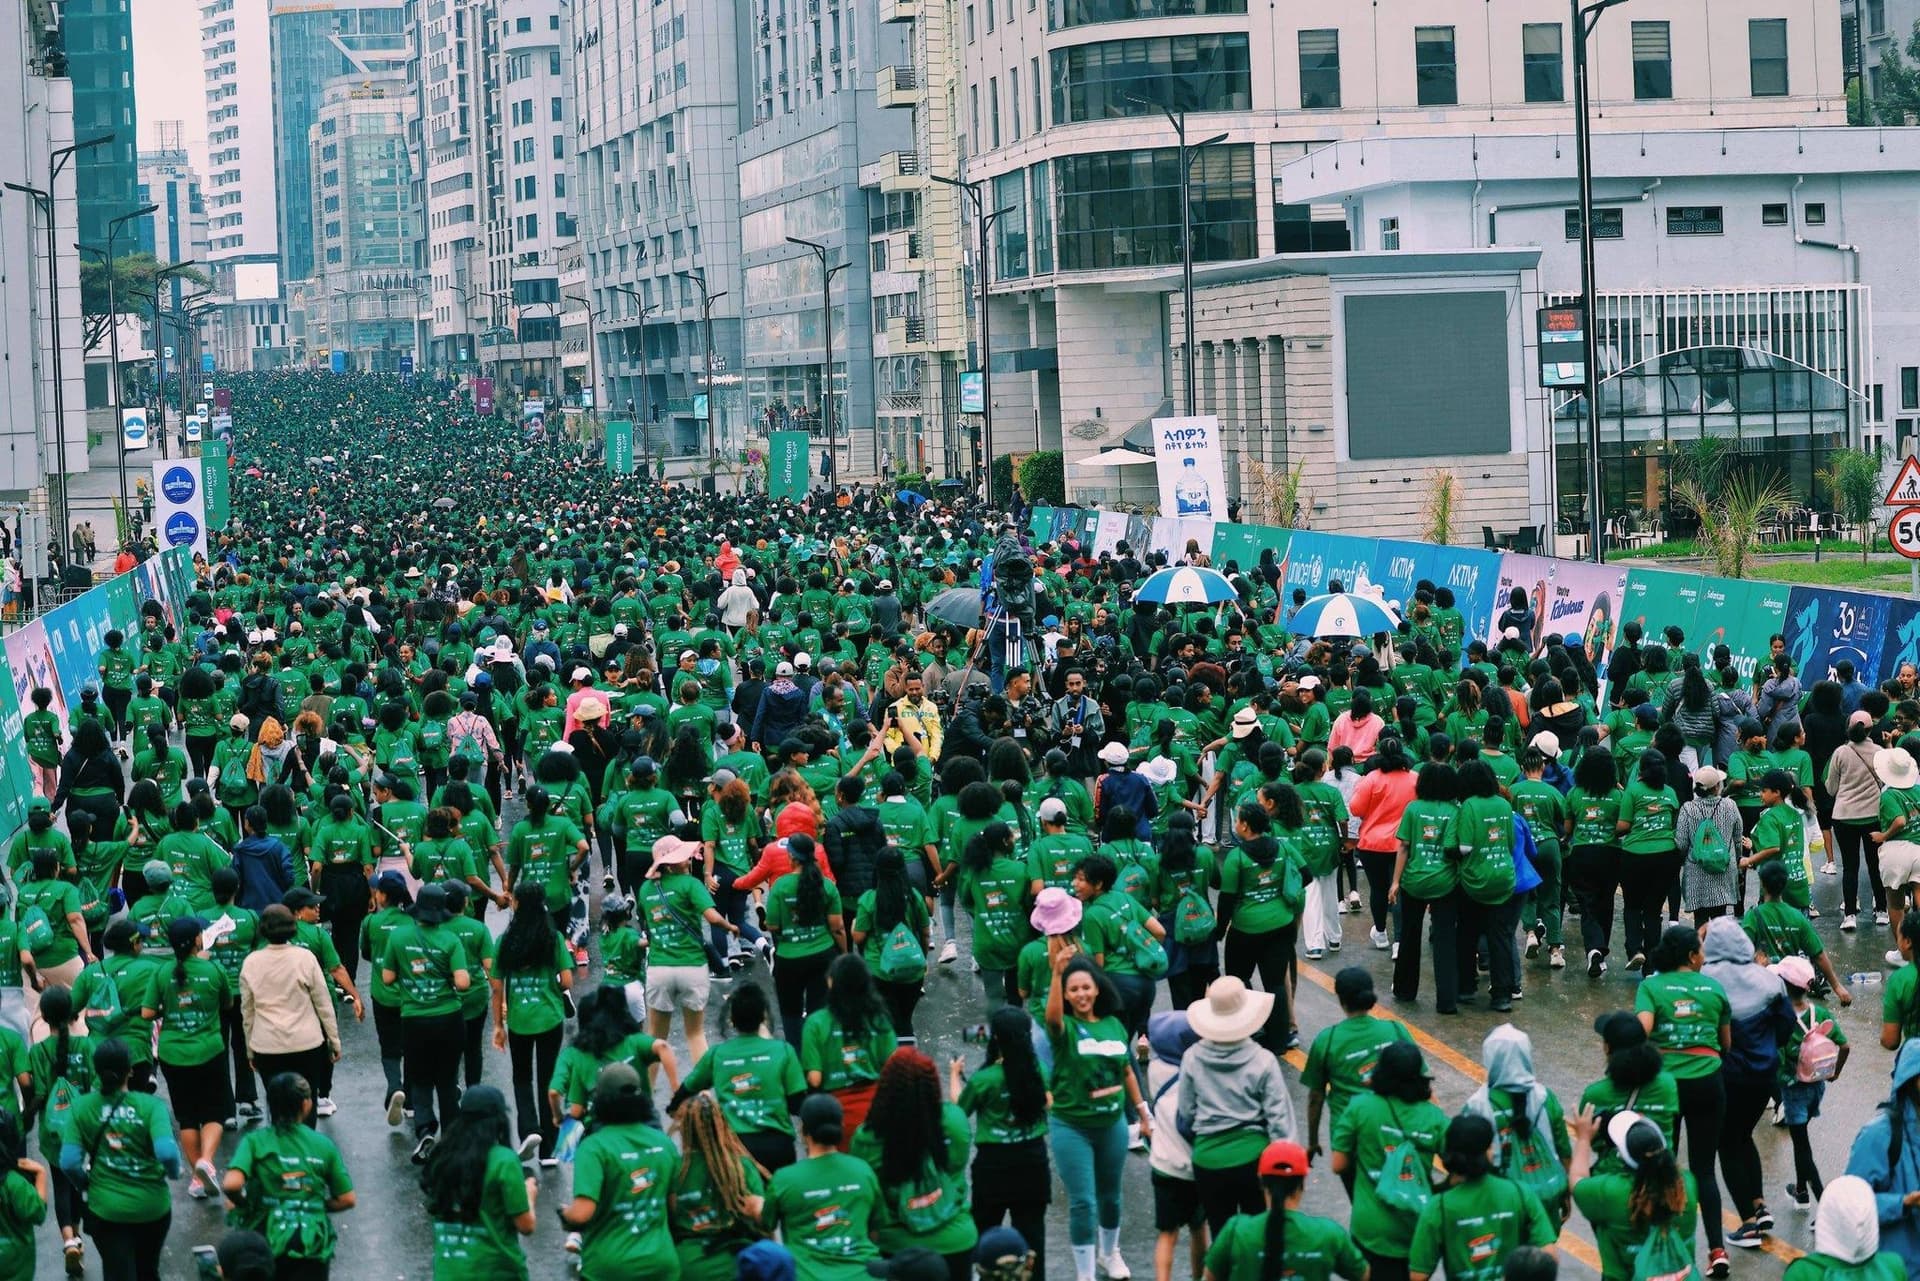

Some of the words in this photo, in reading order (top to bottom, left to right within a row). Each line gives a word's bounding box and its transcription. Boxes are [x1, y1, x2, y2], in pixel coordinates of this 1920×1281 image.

[784, 441, 792, 484] Safaricom
[206, 466, 214, 510] Safaricom
[1288, 553, 1314, 585] unicef
